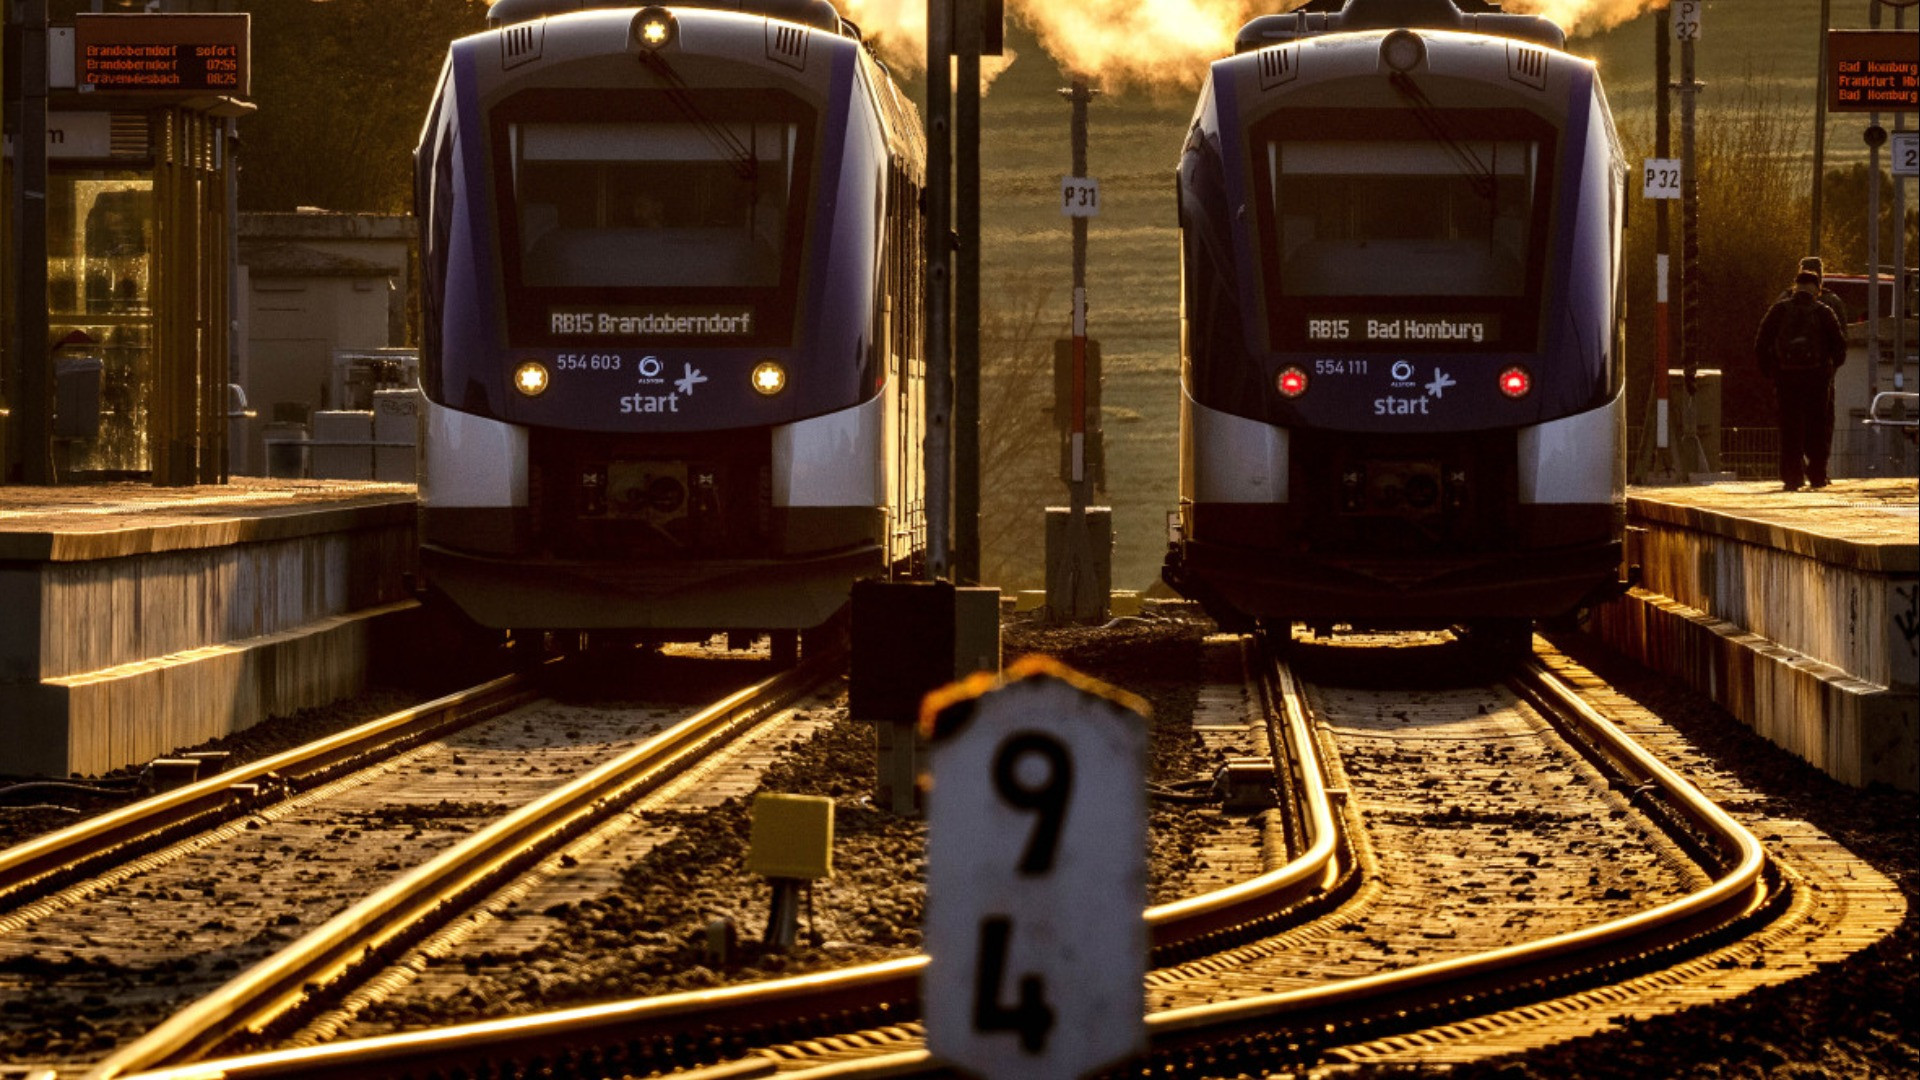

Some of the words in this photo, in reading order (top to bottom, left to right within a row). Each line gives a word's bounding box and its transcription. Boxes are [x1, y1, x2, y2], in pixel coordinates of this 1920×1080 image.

[1682, 2, 1694, 20] P
[1676, 22, 1698, 40] 32
[87, 45, 177, 57] Brandoberndorf
[196, 45, 236, 57] sofort
[87, 59, 177, 70] Brandoberndorf
[1839, 61, 1860, 72] Bad
[1868, 61, 1918, 75] Homburg
[1839, 75, 1895, 87] Frankfurt
[1839, 89, 1860, 100] Bad
[1868, 89, 1918, 103] Homburg
[1905, 149, 1917, 167] 2
[1646, 168, 1655, 188] P
[1659, 169, 1679, 188] 32
[1064, 186, 1075, 207] P
[1078, 186, 1096, 207] 31
[551, 313, 594, 334] RB15
[598, 313, 750, 334] Brandoberndorf
[1309, 319, 1350, 339] RB15
[1367, 319, 1400, 339] Bad
[1404, 319, 1484, 342] Homburg
[557, 354, 587, 370] 554
[590, 354, 621, 370] 603
[1315, 360, 1345, 375] 554
[1349, 360, 1368, 375] 111
[620, 392, 679, 413] start
[1374, 395, 1430, 415] start
[991, 729, 1076, 879] 9
[971, 913, 1059, 1057] 4
